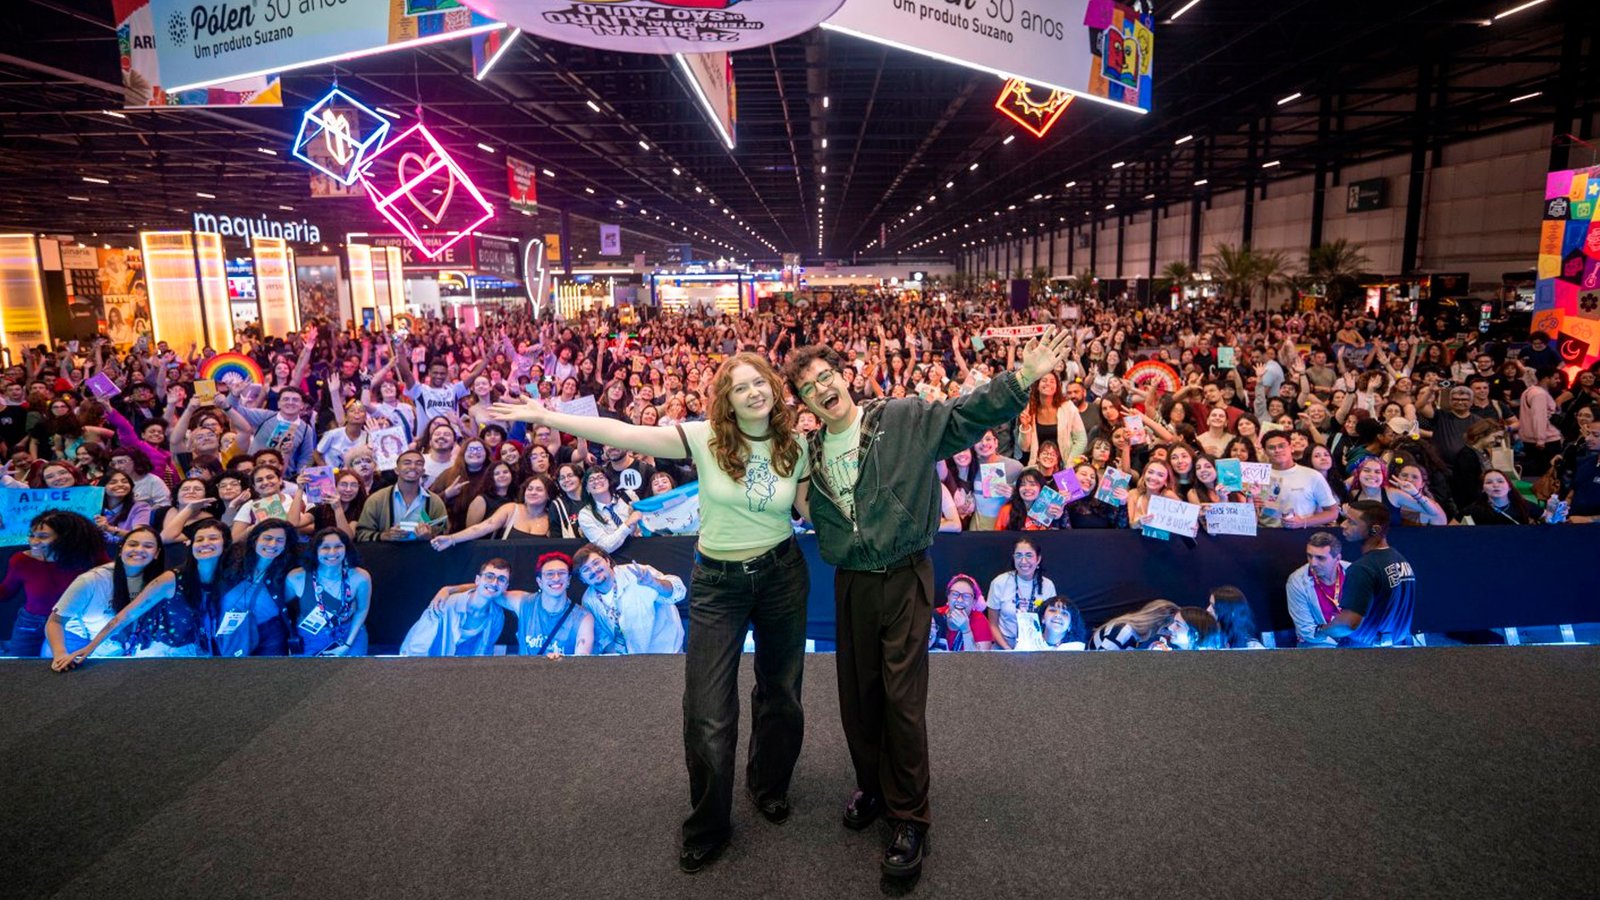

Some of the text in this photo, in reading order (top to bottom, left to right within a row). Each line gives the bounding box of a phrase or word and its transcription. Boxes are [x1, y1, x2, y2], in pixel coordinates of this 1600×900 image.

[191, 3, 255, 40] Pólen
[264, 0, 291, 22] 30
[543, 12, 641, 27] LIVRO
[578, 4, 666, 20] PAULO
[672, 10, 726, 22] SÃO
[920, 4, 969, 30] produto
[972, 17, 1013, 43] Suzano
[986, 0, 1064, 40] 30 anos
[194, 25, 294, 59] Um produto Suzano
[581, 23, 700, 38] BIENAL
[193, 212, 321, 248] maquinaria
[19, 490, 71, 503] ALICE
